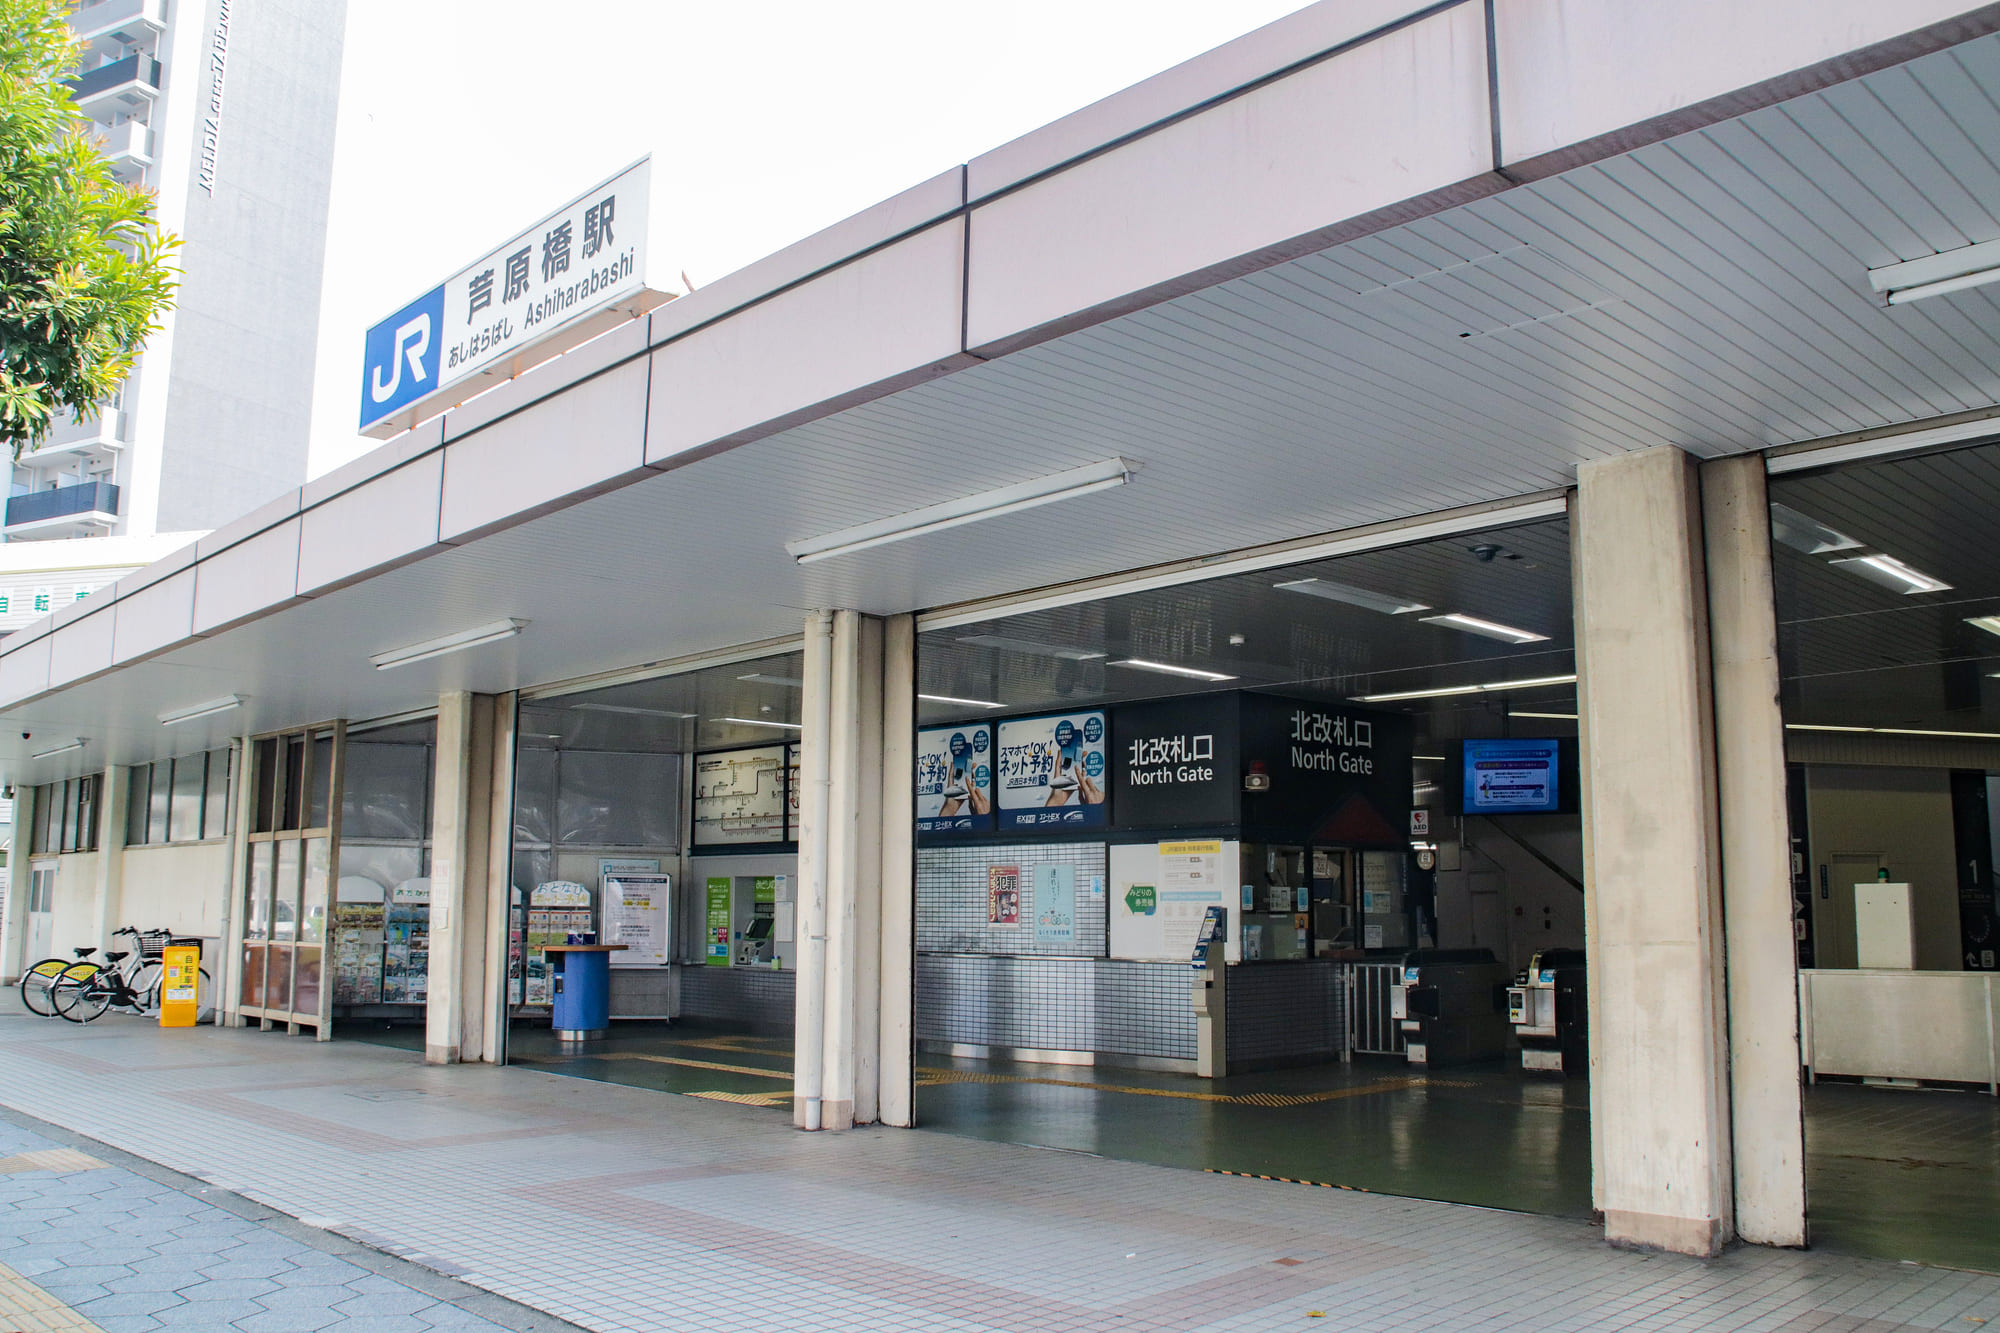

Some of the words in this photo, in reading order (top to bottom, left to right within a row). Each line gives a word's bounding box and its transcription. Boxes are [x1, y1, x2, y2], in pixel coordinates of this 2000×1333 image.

[466, 194, 616, 325] 芦原橋駅
[448, 316, 514, 370] あしはらばし
[524, 246, 634, 329] Ashiharabashi
[371, 312, 431, 404] JR
[1290, 709, 1372, 749] 北改札口
[1128, 734, 1213, 767] 北改札口
[1291, 746, 1336, 771] North
[1338, 751, 1373, 775] Gate
[1000, 754, 1054, 776] ネット予約
[1130, 767, 1173, 786] North
[1176, 765, 1213, 782] Gate
[996, 875, 1017, 891] 犯罪
[1968, 859, 1978, 885] 1
[537, 883, 585, 896] おとなび
[1129, 889, 1153, 897] みどりの
